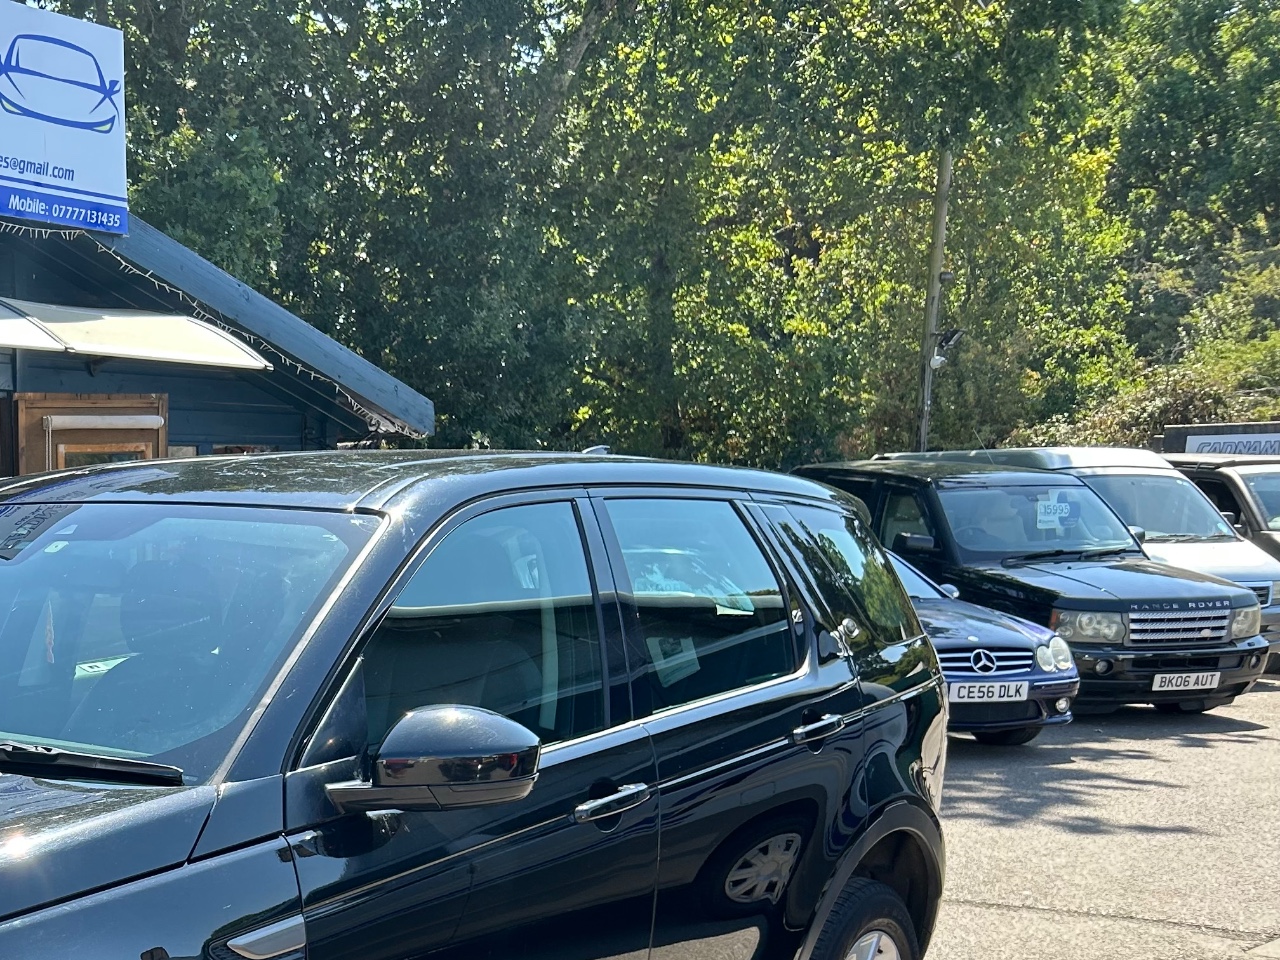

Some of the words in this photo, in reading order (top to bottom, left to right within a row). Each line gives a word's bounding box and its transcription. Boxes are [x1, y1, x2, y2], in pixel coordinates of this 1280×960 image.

[8, 194, 49, 216] Mobile:
[52, 204, 121, 227] 07777131435
[1188, 600, 1230, 608] ROVER
[1158, 675, 1190, 688] BK06
[1193, 673, 1216, 687] AUT
[957, 685, 995, 699] CE56
[997, 683, 1023, 698] DLK
